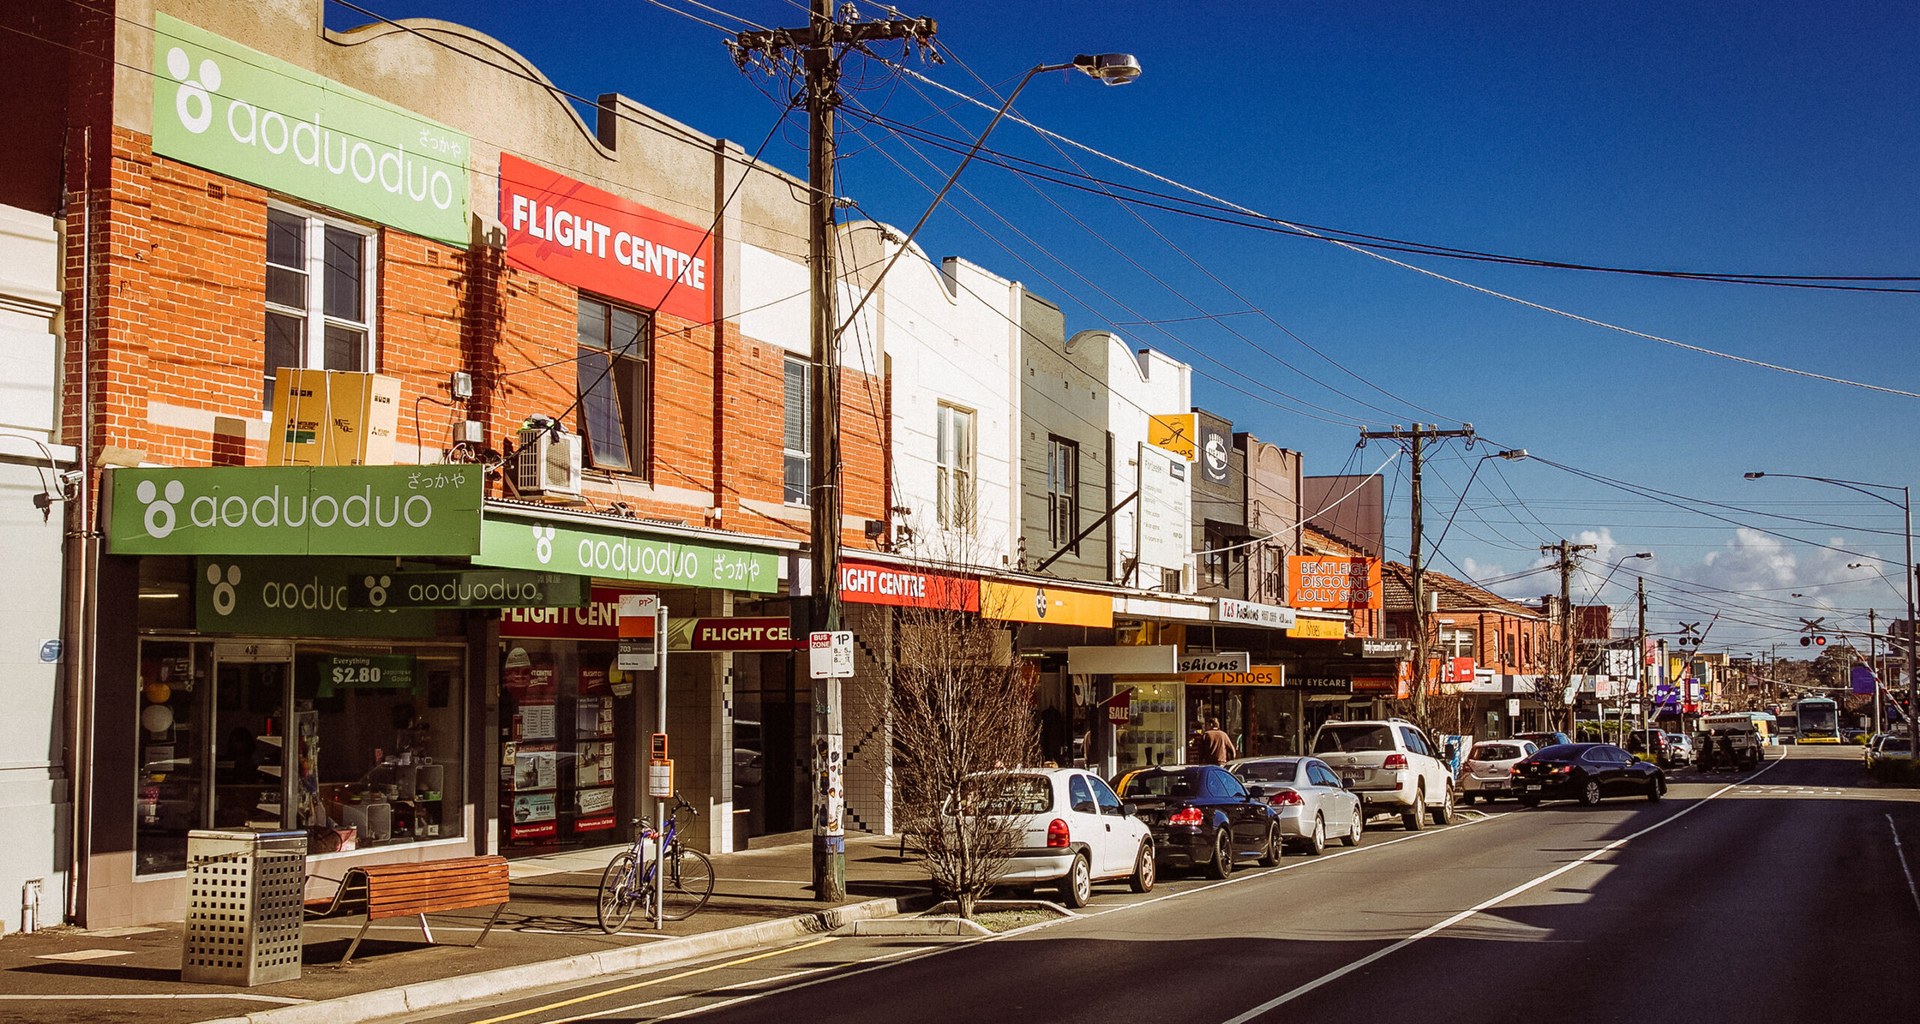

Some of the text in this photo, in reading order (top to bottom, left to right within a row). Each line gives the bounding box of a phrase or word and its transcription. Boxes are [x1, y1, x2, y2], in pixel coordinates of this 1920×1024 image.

[419, 128, 462, 159] ざっかや
[227, 99, 452, 210] aoduoduo
[512, 194, 705, 291] FLIGHT CENTRE
[407, 472, 466, 490] ざっかや
[190, 484, 432, 528] aoduoduo
[578, 537, 698, 579] aoduoduo
[714, 553, 760, 583] ざっかや
[1300, 562, 1370, 576] BENTLEIGH
[408, 578, 537, 602] aoduoduo
[838, 567, 925, 598] IGHT CENTRE
[1301, 576, 1370, 589] DISCOUNT
[1297, 589, 1374, 602] LOLLY SHOP
[576, 603, 619, 627] CENT
[702, 628, 764, 641] FLIGHT
[835, 633, 850, 645] 1P
[333, 657, 370, 666] Everything
[332, 667, 381, 684] $2.80
[1286, 678, 1303, 687] MILY
[1307, 678, 1346, 687] EYECARE
[1108, 706, 1129, 720] SALE
